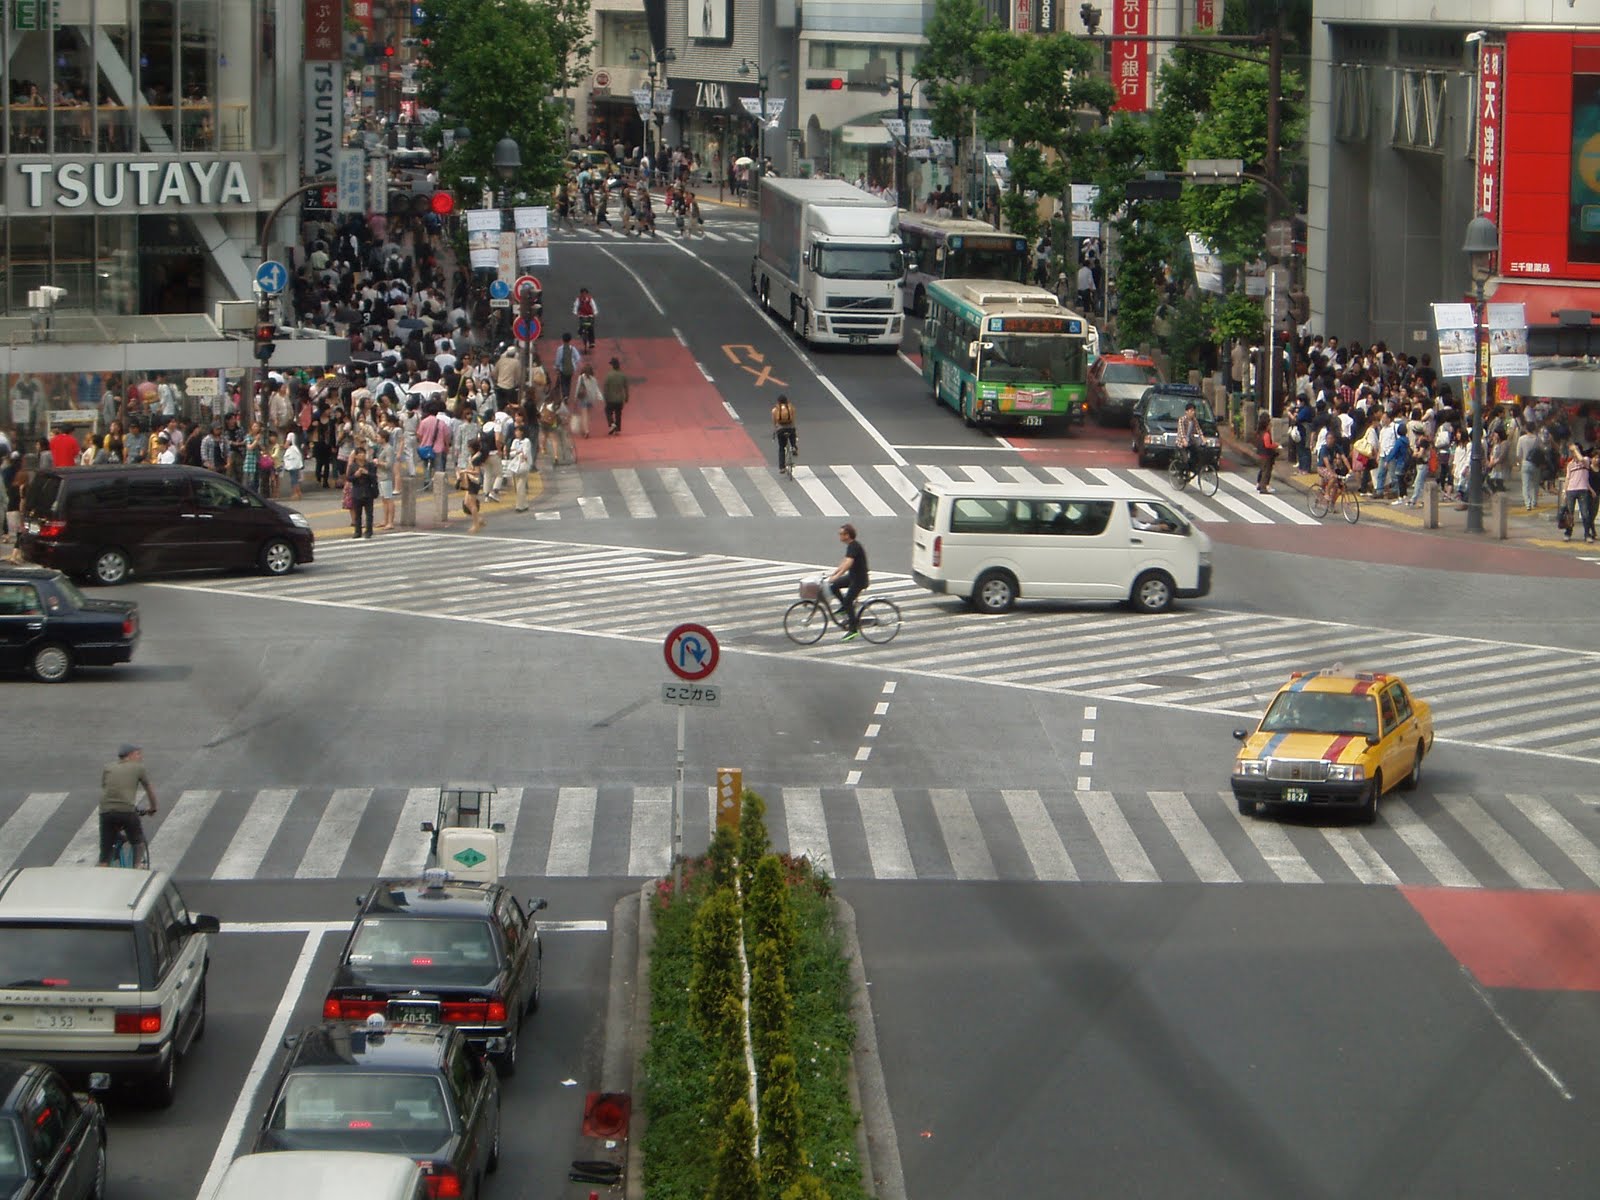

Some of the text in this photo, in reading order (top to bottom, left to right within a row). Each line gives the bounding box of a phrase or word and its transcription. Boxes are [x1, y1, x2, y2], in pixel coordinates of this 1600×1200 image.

[696, 82, 728, 109] ZARA
[313, 62, 333, 174] TSUTAYA
[1483, 81, 1496, 213] 天津甘
[21, 162, 251, 208] TSUTAYA
[1510, 262, 1550, 273] 三千里薬品
[666, 687, 717, 701] ここから
